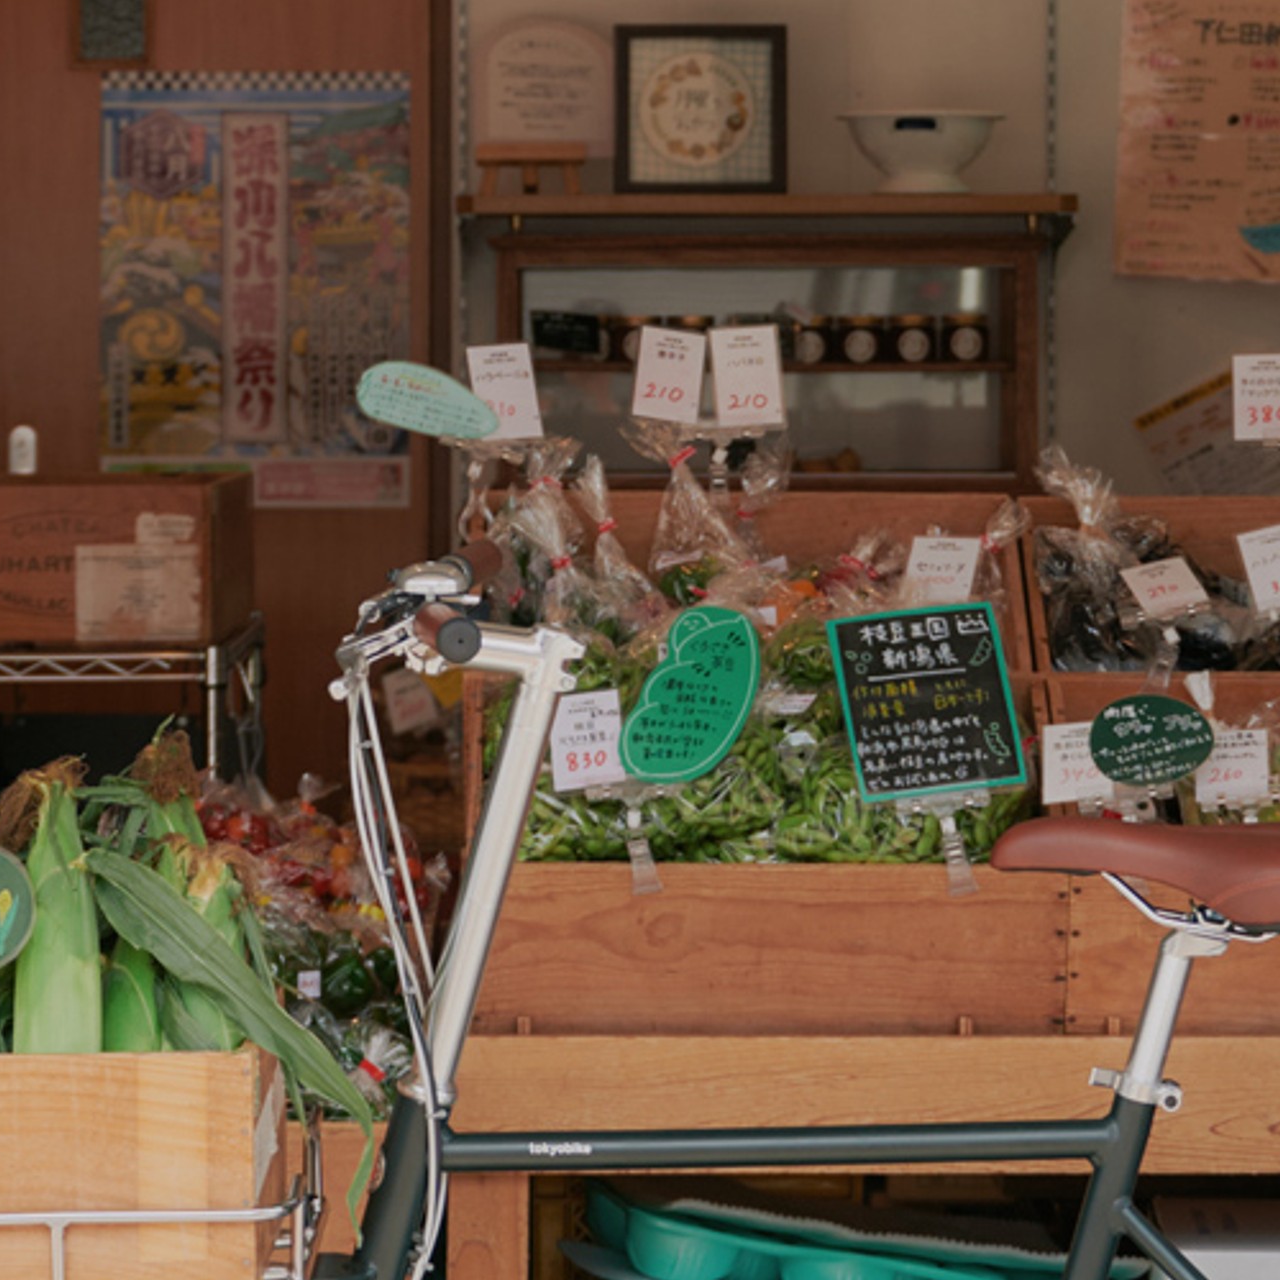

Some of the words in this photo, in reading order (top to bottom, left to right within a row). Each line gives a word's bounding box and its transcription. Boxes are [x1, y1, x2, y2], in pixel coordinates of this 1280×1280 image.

[643, 381, 685, 403] 210
[727, 393, 769, 410] 210
[858, 615, 950, 646] 枝豆王国
[881, 641, 959, 670] 新潟県
[566, 749, 607, 771] 830
[1208, 768, 1243, 784] 260
[528, 1141, 592, 1158] tokyobike
